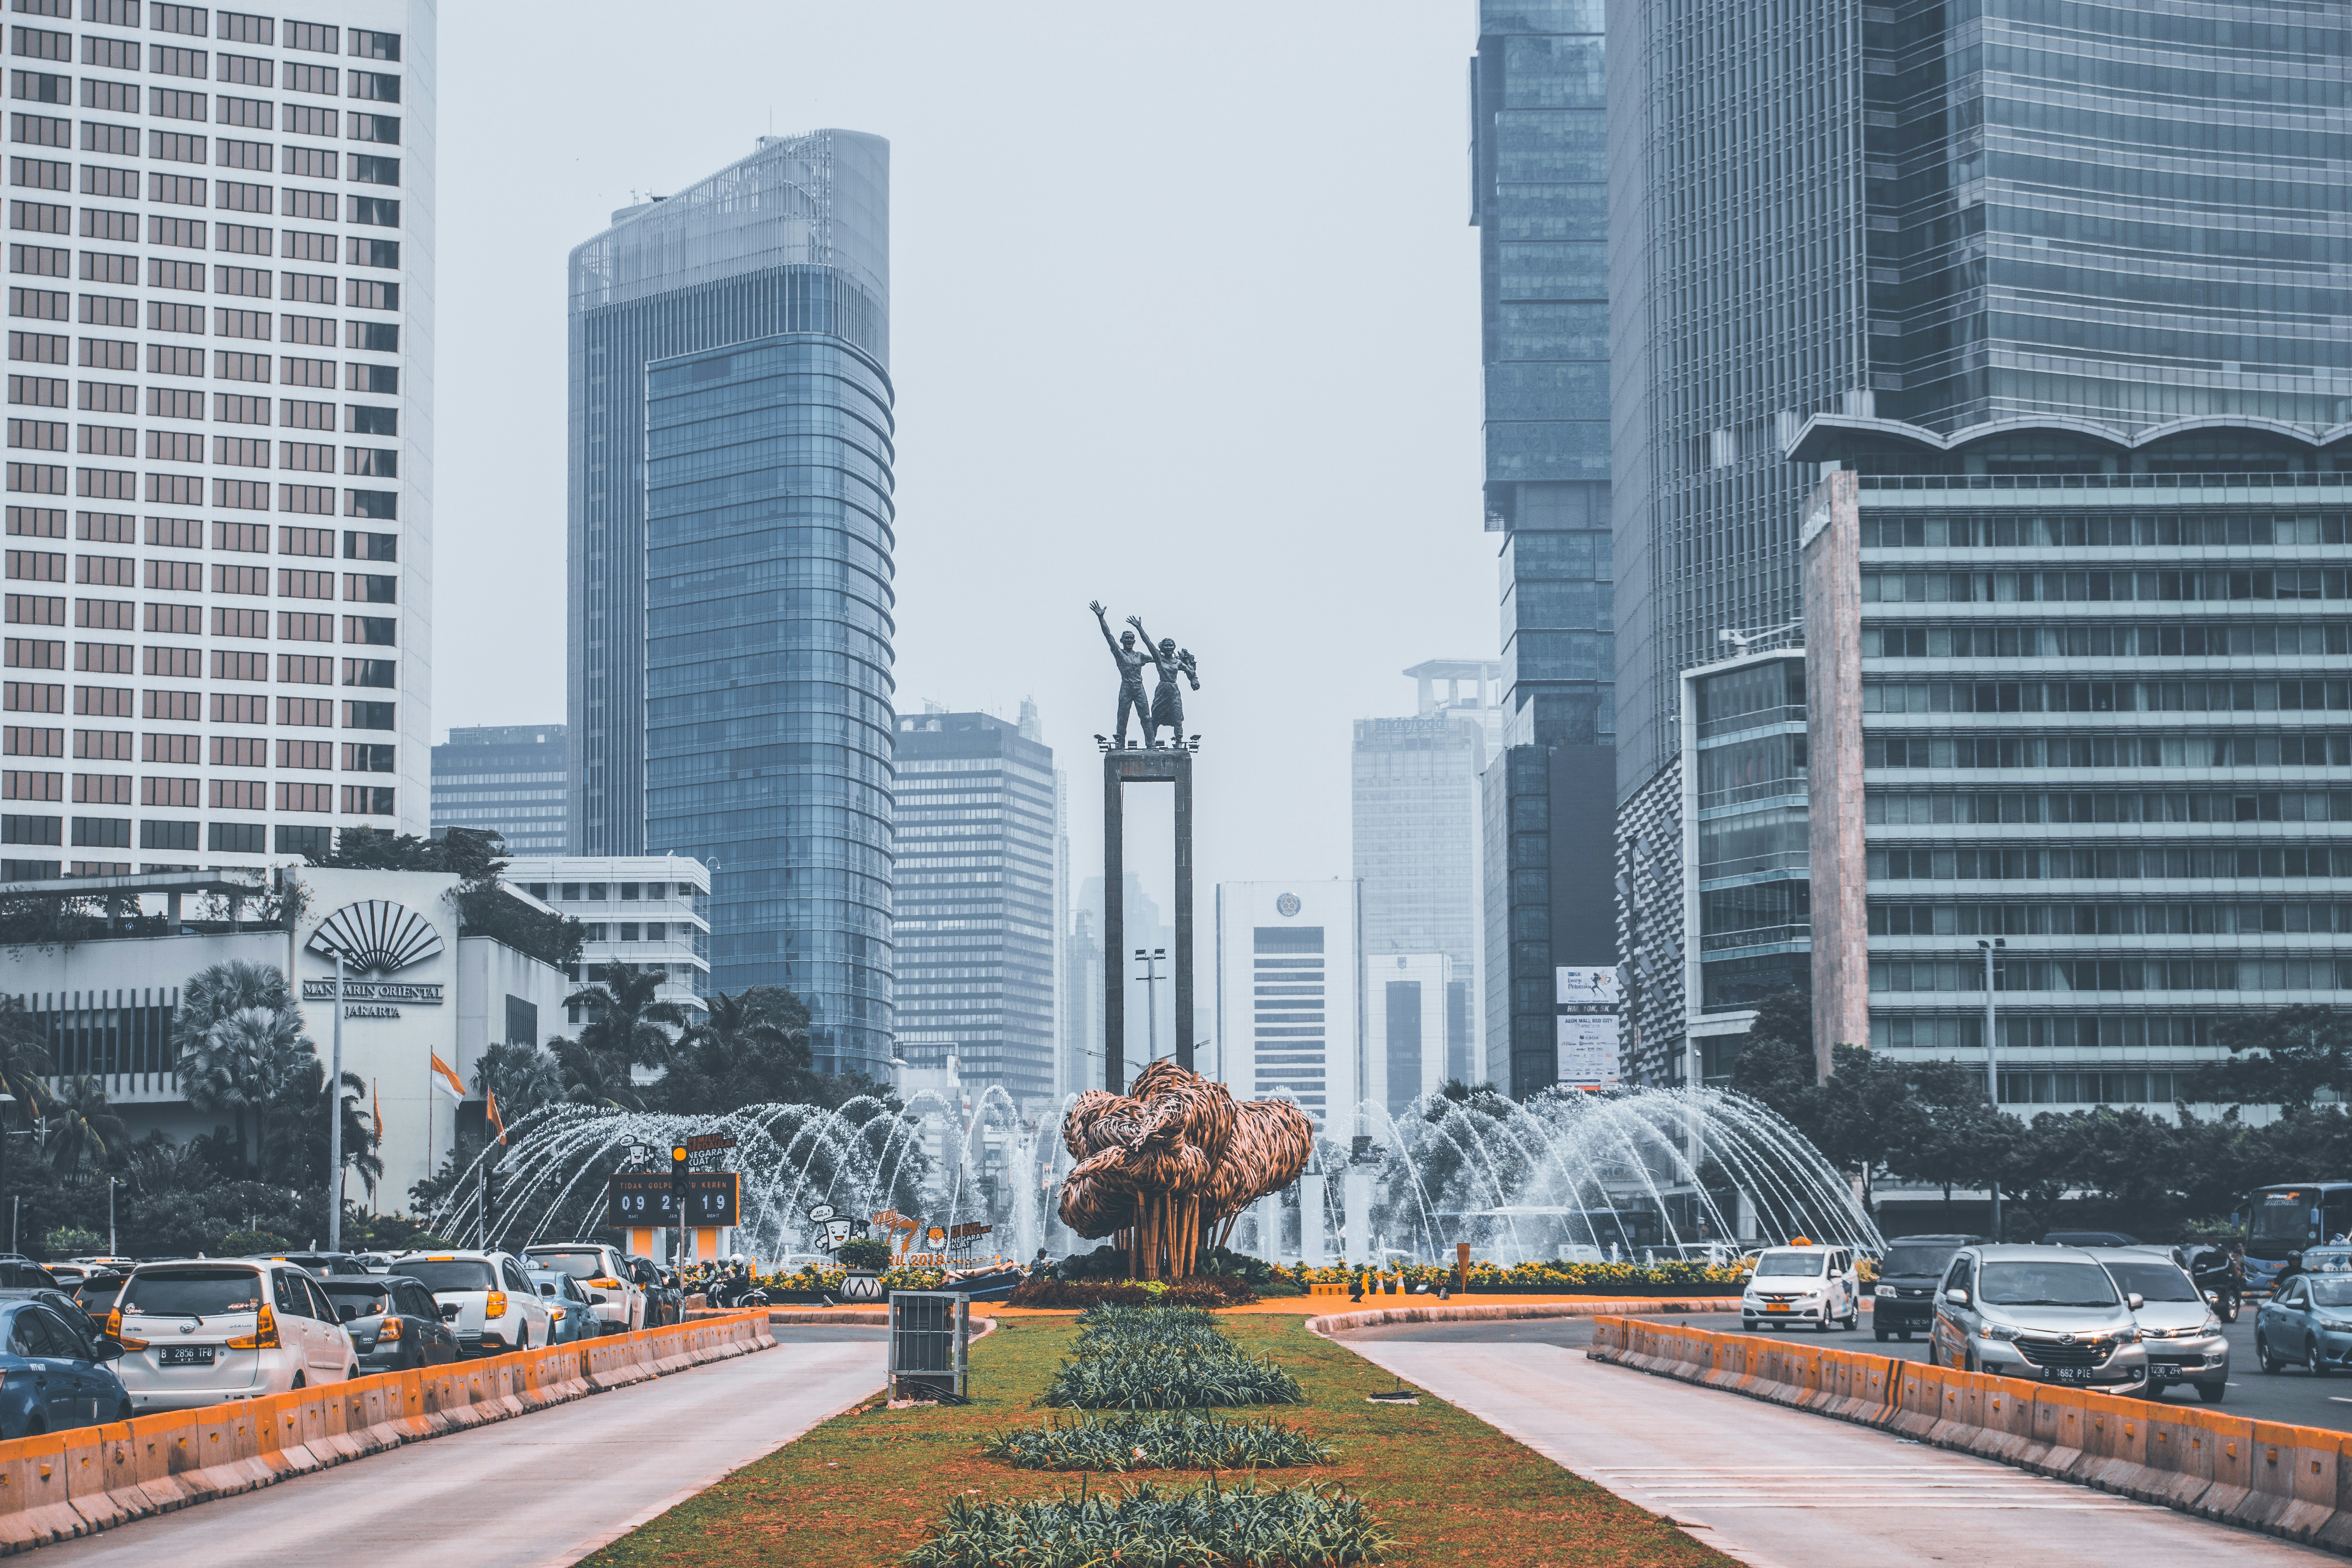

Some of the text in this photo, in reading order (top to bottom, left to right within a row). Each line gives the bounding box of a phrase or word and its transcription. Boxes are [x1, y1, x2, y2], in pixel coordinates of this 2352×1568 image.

[1703, 930, 1785, 950] GRAMEDIA
[304, 984, 444, 998] MANARIN ORIENTAL
[345, 1005, 401, 1018] JAKARTA
[688, 1133, 722, 1143] PEMILIH
[688, 1148, 723, 1159] NEGARA
[688, 1156, 710, 1166] KUAT
[873, 1210, 898, 1224] RABU
[886, 1218, 924, 1253] 17
[951, 1234, 981, 1243] NEGARA
[951, 1241, 970, 1250] KUAT
[887, 1254, 945, 1266] RIL 2019
[162, 1348, 167, 1358] B
[175, 1348, 194, 1357] 2856
[2044, 1368, 2091, 1378] B 1682 PIE
